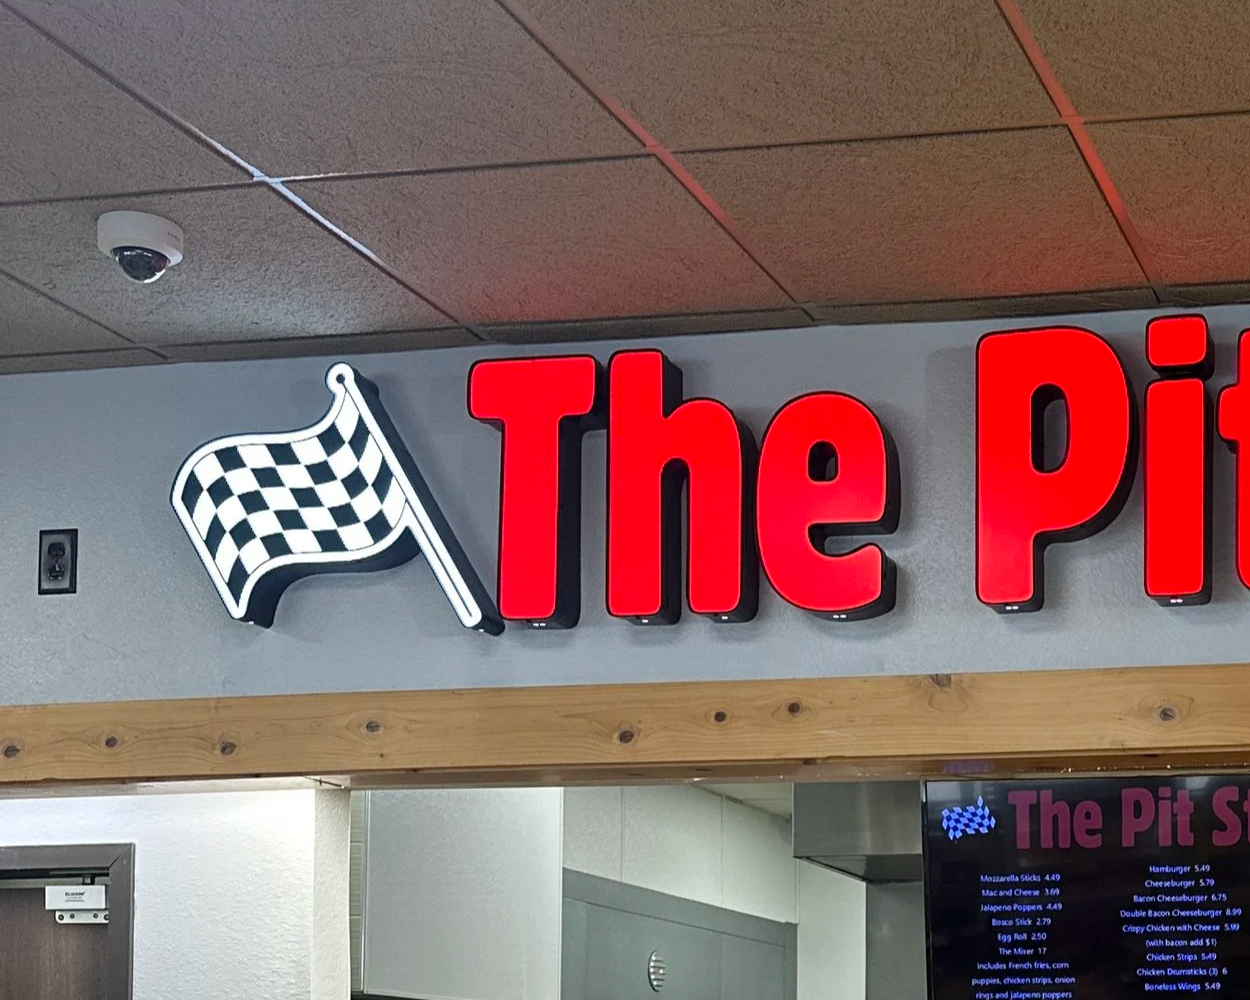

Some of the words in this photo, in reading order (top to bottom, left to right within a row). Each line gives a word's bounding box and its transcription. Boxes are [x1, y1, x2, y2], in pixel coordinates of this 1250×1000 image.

[468, 350, 897, 629] The
[1008, 790, 1103, 850] The
[1121, 787, 1195, 848] Pit
[1149, 865, 1190, 874] Hamburger
[980, 874, 1019, 882] Mozzarella
[1145, 879, 1194, 888] Cheeseburger
[1014, 888, 1039, 896] Cheese
[1157, 894, 1207, 903] Cheeseburger
[981, 904, 1012, 912] Jalapeno
[1013, 903, 1042, 912] Poppers
[1148, 909, 1170, 917] Bacon
[1172, 908, 1222, 918] Cheeseburger
[998, 933, 1011, 943] Egg
[1146, 953, 1175, 961] Chicken
[1177, 953, 1197, 962] Strips
[1145, 983, 1176, 991] Boneless
[1177, 982, 1200, 992] Wings
